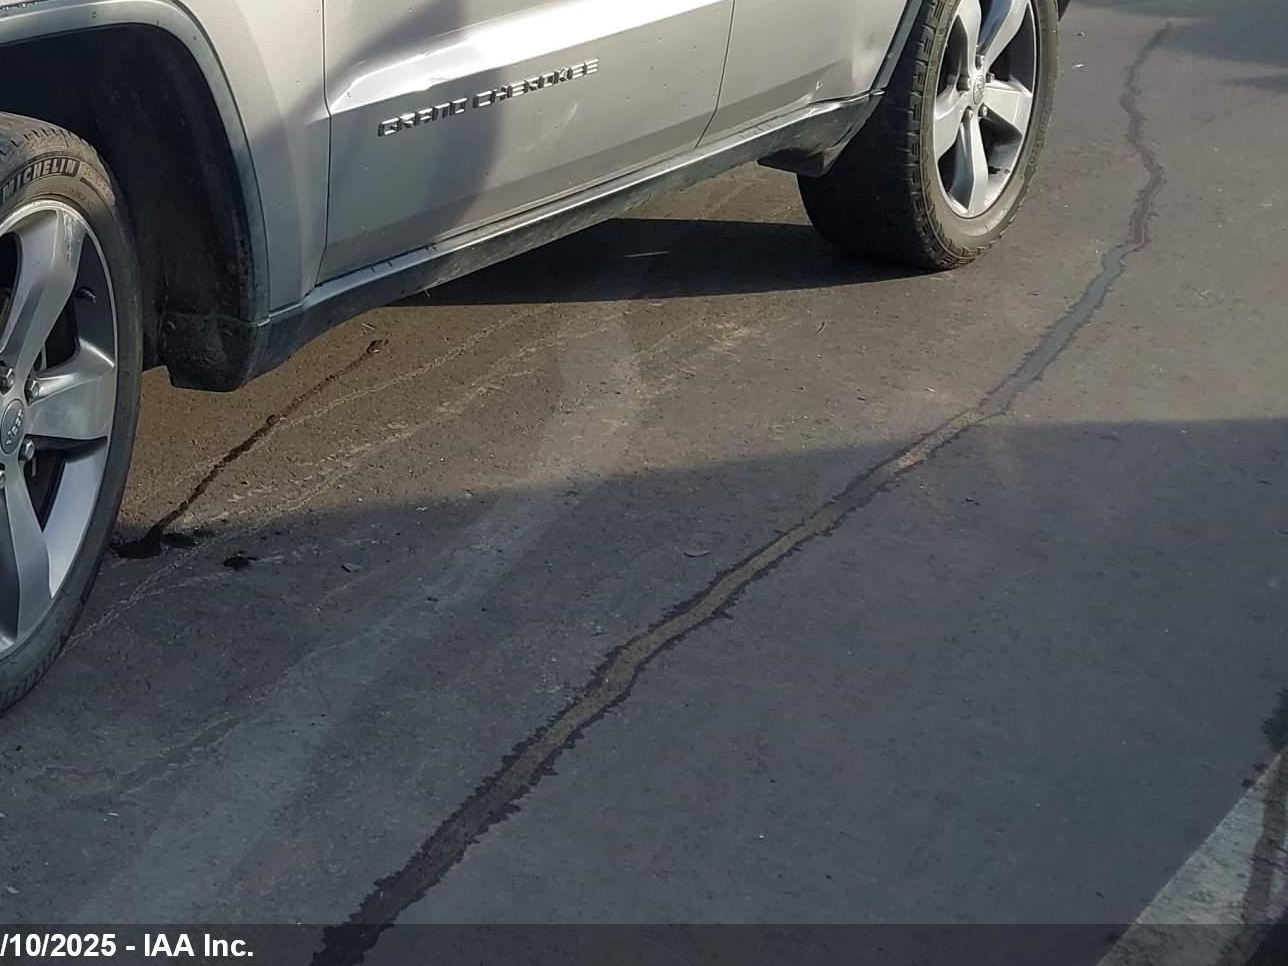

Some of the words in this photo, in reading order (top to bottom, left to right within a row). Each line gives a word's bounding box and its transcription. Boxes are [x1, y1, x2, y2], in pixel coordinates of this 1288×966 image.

[377, 97, 468, 137] GRAND
[472, 58, 600, 109] CHEROKEE
[1, 155, 77, 204] MICHELIN
